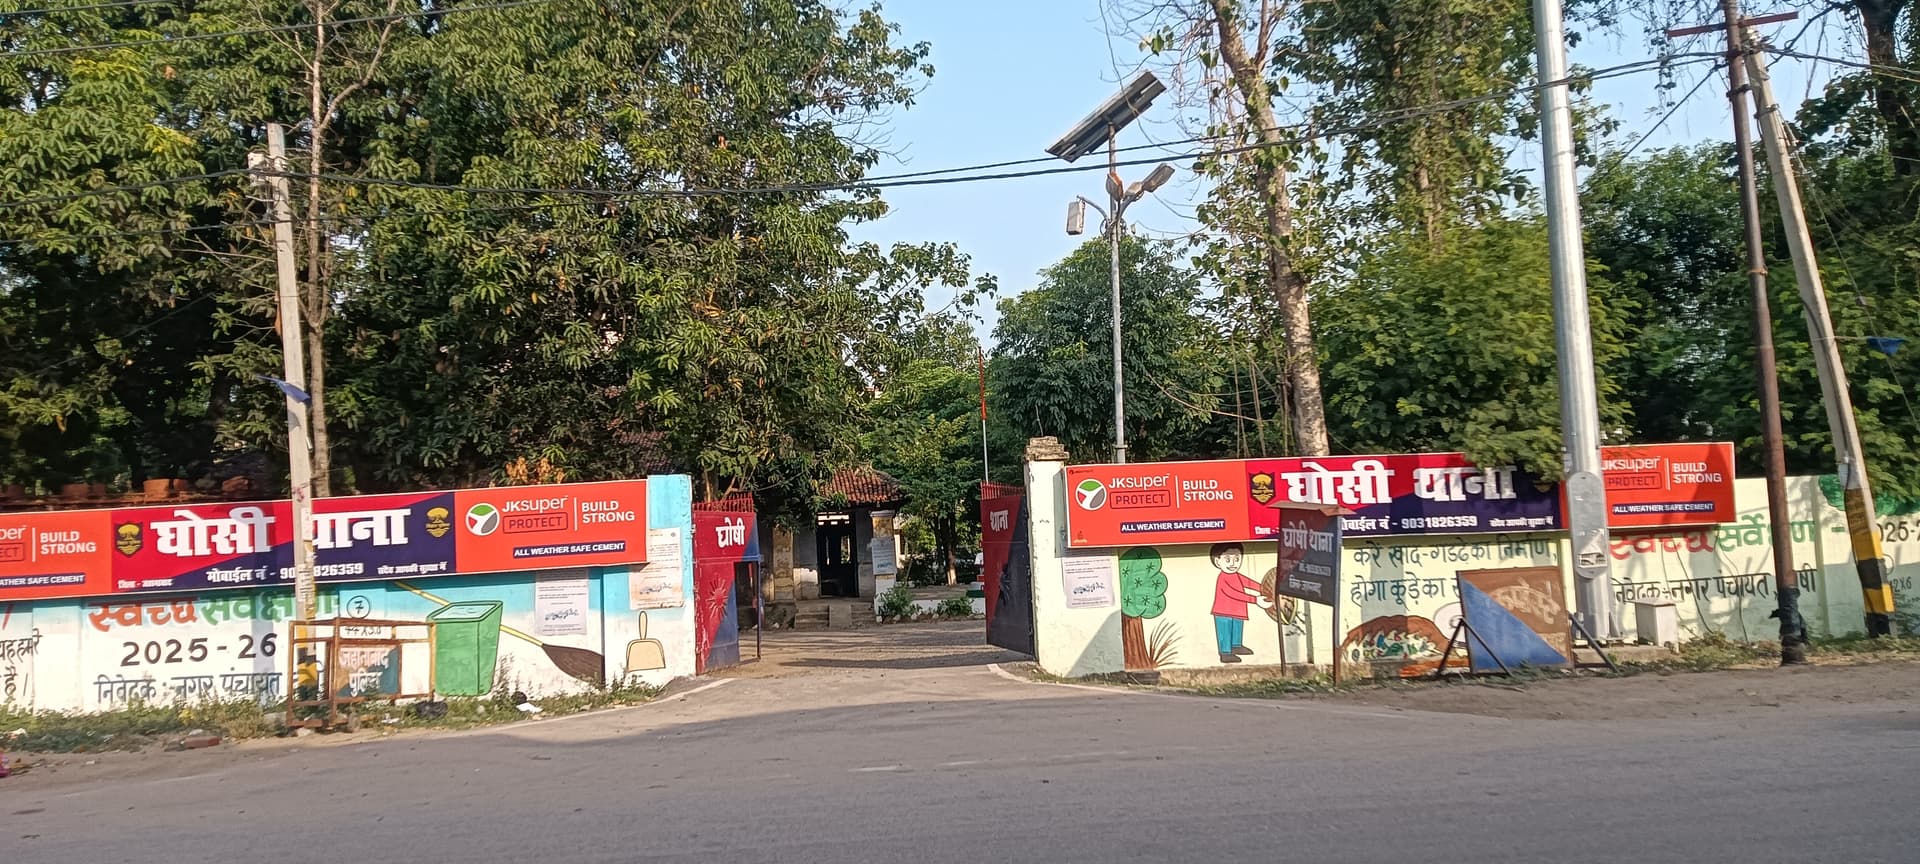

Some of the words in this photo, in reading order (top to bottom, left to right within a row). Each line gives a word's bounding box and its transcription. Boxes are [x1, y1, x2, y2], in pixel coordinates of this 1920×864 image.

[1673, 463, 1707, 472] BUILD
[1281, 460, 1395, 504] घोसी
[1413, 466, 1517, 501] थाना
[1608, 476, 1656, 487] PROTECT
[1673, 473, 1722, 483] STRONG
[1182, 480, 1218, 490] BUILD
[1115, 493, 1165, 505] PROTECT
[1184, 490, 1233, 501] STRONG
[581, 501, 619, 512] BUILD
[1614, 505, 1628, 513] ALL
[1630, 504, 1664, 512] WEATHER
[1665, 504, 1683, 512] SAFE
[1684, 503, 1714, 511] CEMENT
[509, 516, 563, 529] PROTECT
[582, 511, 635, 523] STRONG
[990, 509, 1009, 532] थाना
[1402, 515, 1477, 530] 9031826359
[150, 507, 276, 556] घोसी
[1121, 523, 1136, 531] ALL
[1137, 521, 1173, 530] WEATHER
[1173, 521, 1193, 529] SAFE
[1194, 520, 1224, 529] CEMENT
[40, 531, 80, 543] BUILD
[715, 516, 746, 548] घोषी
[40, 542, 96, 555] STRONG
[531, 546, 569, 555] WEATHER
[571, 544, 591, 553] SAFE
[592, 542, 625, 551] CEMENT
[206, 567, 252, 583] मोबाईल
[280, 562, 364, 580] 90826359
[27, 576, 49, 585] SAFE
[50, 575, 85, 583] CEMENT
[1351, 575, 1387, 607] होगा
[120, 637, 209, 667] 2025
[238, 633, 278, 660] 26
[94, 674, 156, 703] निवेदक
[220, 667, 283, 698] पंचायत
